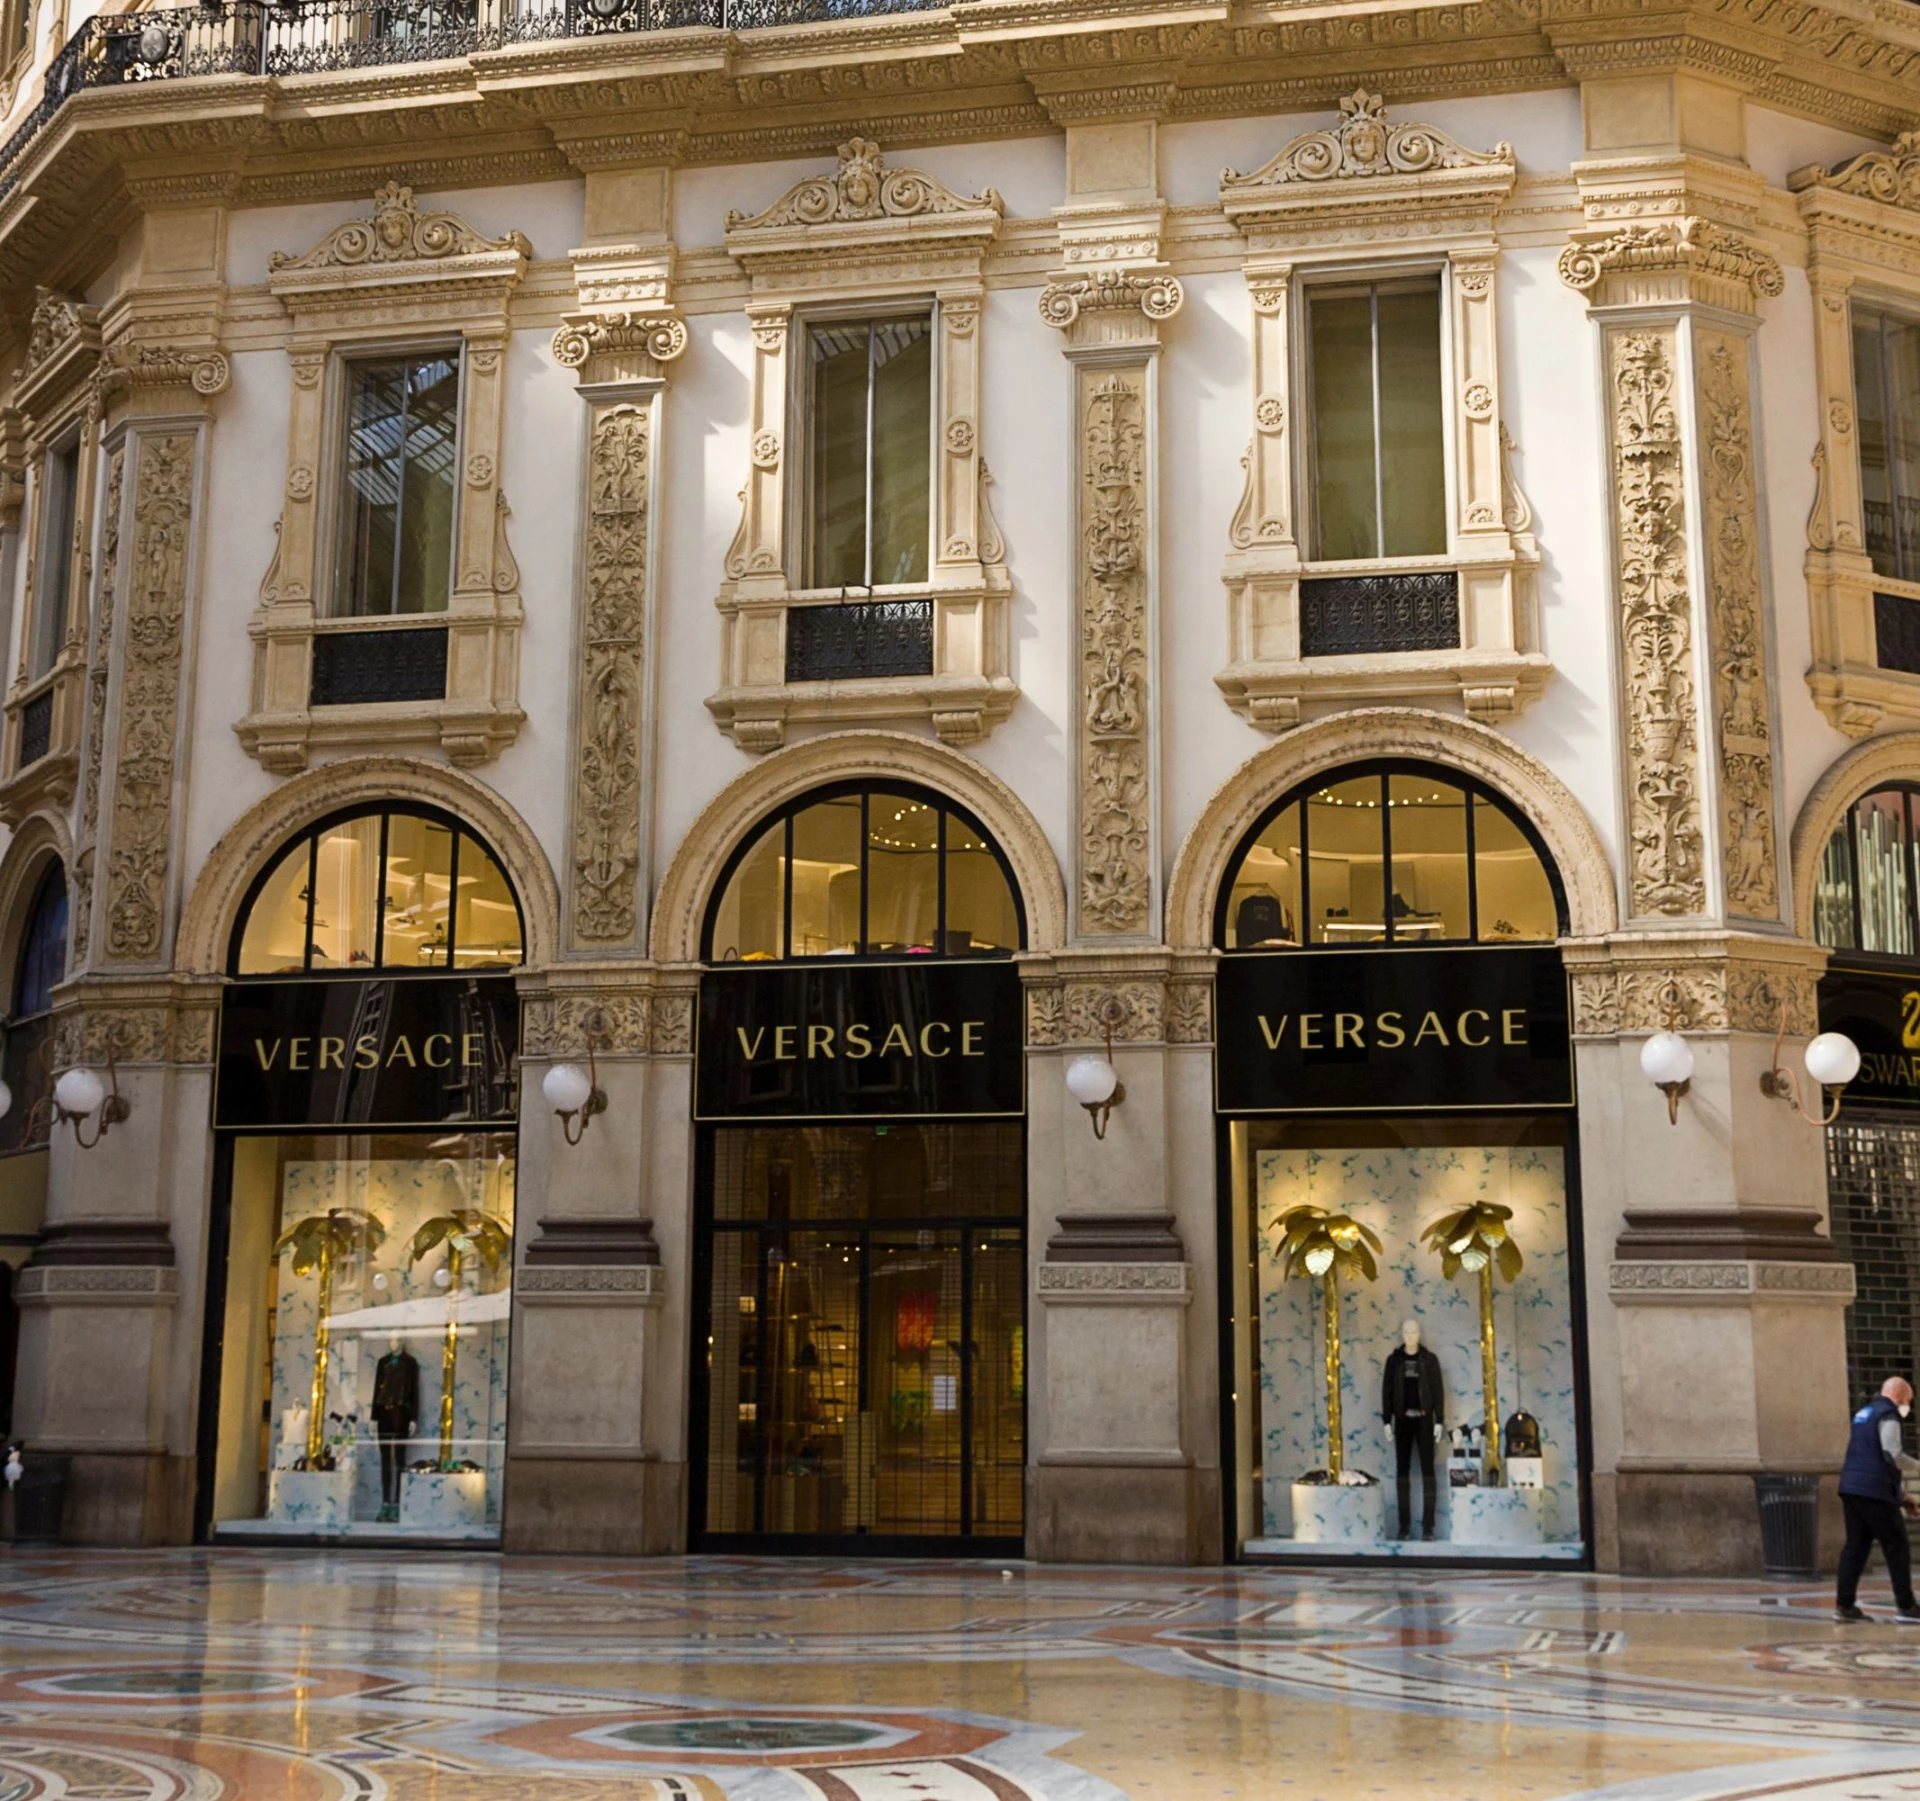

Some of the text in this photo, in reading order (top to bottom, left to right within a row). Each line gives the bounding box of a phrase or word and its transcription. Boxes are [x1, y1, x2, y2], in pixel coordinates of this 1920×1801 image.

[736, 1021, 985, 1060] VERSACE
[1257, 1009, 1528, 1050] VERSACE
[254, 1033, 483, 1071] VERSACE
